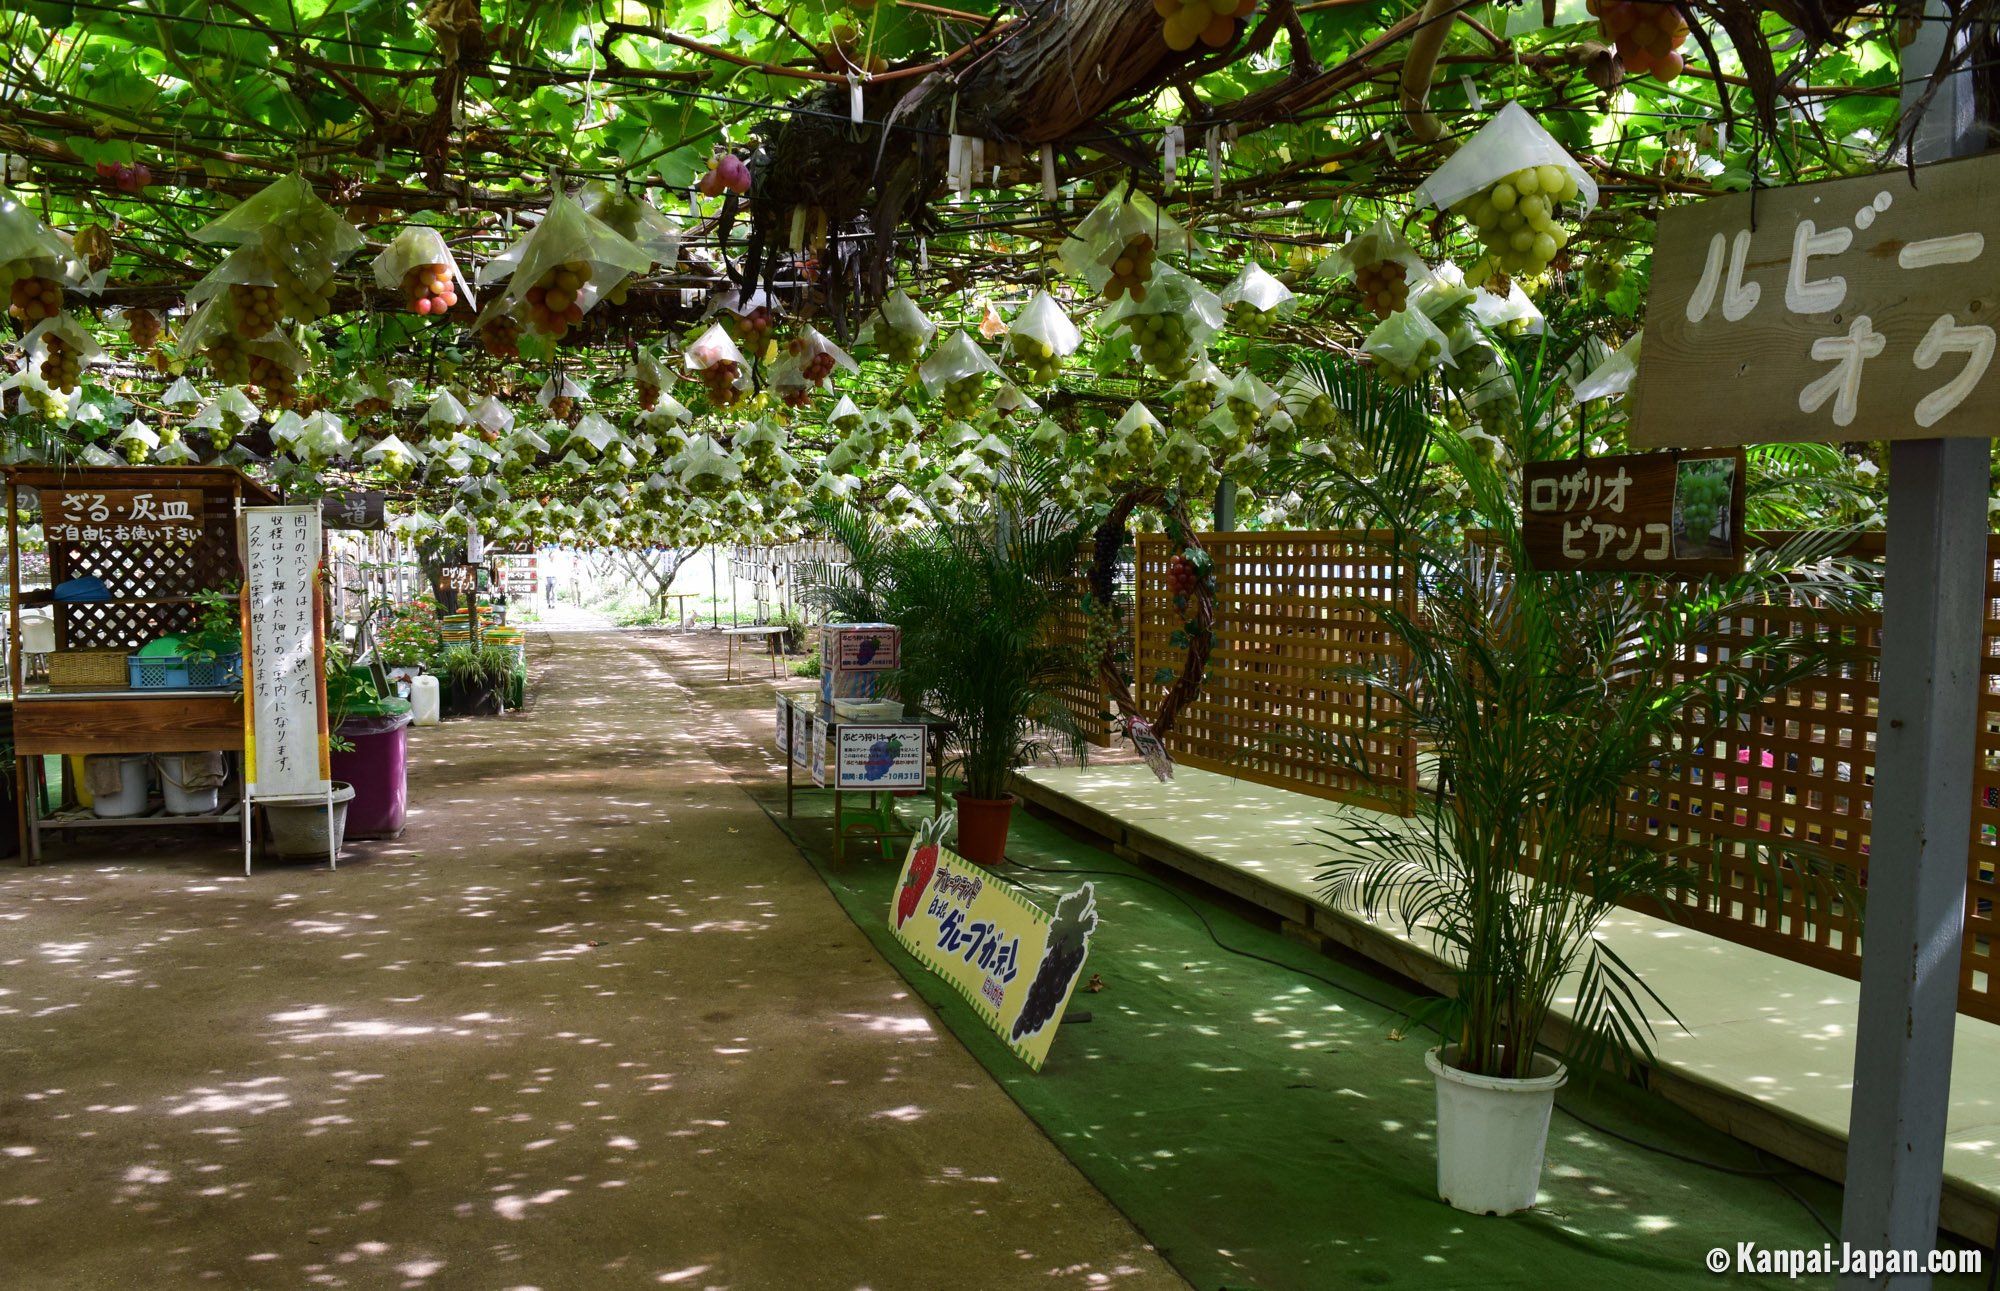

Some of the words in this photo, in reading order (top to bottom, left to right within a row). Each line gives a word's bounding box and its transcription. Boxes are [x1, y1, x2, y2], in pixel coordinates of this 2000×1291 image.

[1686, 190, 1985, 323] ルビー
[1799, 314, 1997, 428] オク
[61, 492, 195, 522] ざる・灰皿
[1530, 466, 1633, 513] ロザリオ
[49, 523, 203, 541] ご自由にお使い下さい
[321, 499, 378, 528] 道
[1562, 515, 1670, 561] ビアンコ
[937, 908, 1018, 983] グレープガーデン
